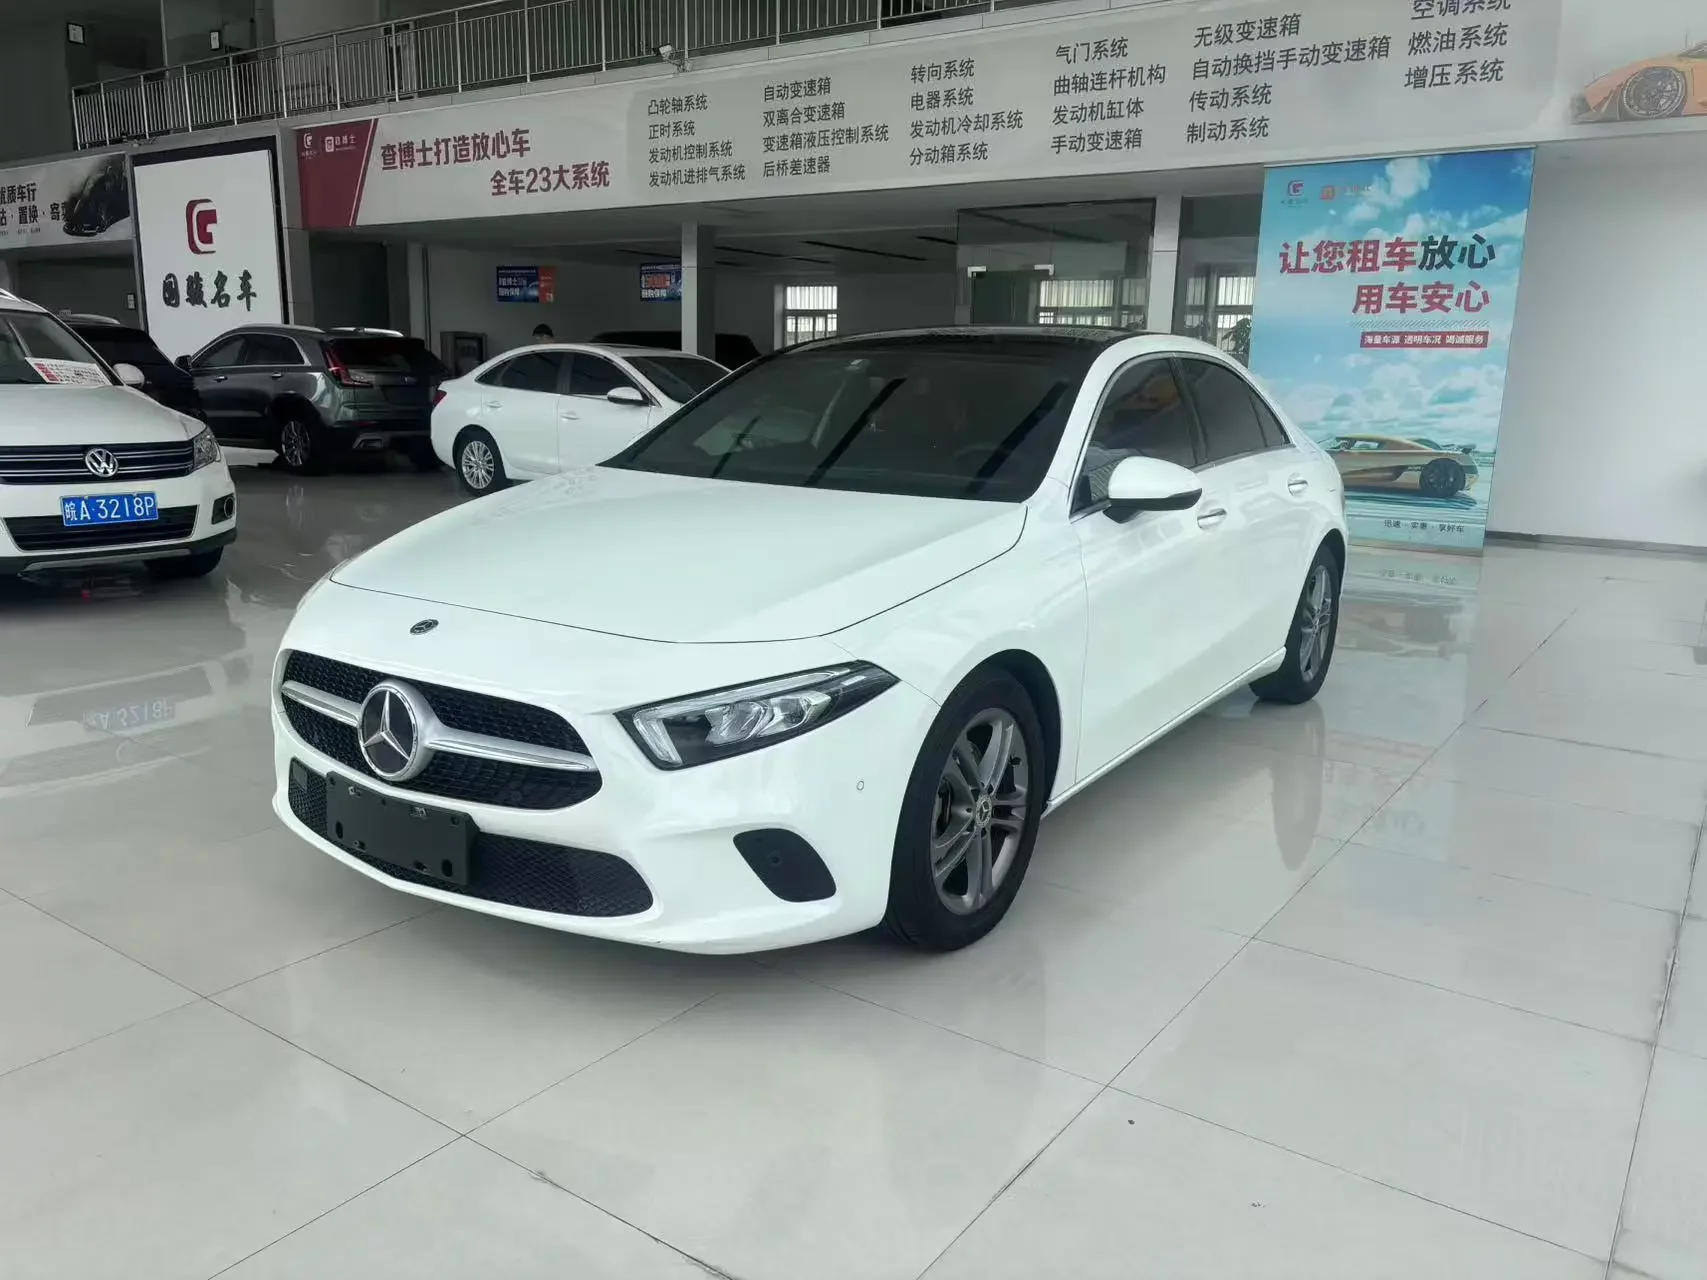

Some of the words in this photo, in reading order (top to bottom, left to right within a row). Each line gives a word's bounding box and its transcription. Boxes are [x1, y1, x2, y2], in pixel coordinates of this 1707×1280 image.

[1193, 12, 1302, 49] 无级变速箱
[1407, 22, 1509, 56] 燃油系统
[1055, 36, 1129, 65] 气门系统
[1192, 35, 1392, 81] 自动换挡手动变速箱
[910, 57, 975, 84] 转向系统
[1053, 64, 1166, 96] 曲轴连杆机构
[1404, 58, 1505, 89] 增压系统
[763, 76, 832, 103] 自动变速箱
[910, 87, 974, 111] 电器系统
[1188, 83, 1272, 112] 传动系统
[647, 93, 708, 117] 凸轮轴系统
[762, 101, 845, 128] 双离合变速箱
[1051, 97, 1144, 126] 发动机缸体
[648, 120, 696, 140] 正时系统
[762, 123, 889, 154] 变速箱液压控制系统
[909, 110, 1024, 139] 发动机冷却系统
[1186, 116, 1270, 144] 制动系统
[380, 128, 531, 171] 查博士打造放心车
[648, 140, 733, 165] 发动机控制系统
[909, 142, 988, 167] 分动箱系统
[1050, 128, 1143, 155] 手动变速箱
[490, 161, 610, 197] 全车23大系统
[648, 163, 746, 189] 发动机进排气系统
[762, 155, 831, 179] 后桥差速器
[1279, 233, 1497, 275] 让您租车放心
[1352, 280, 1491, 315] 用车安心
